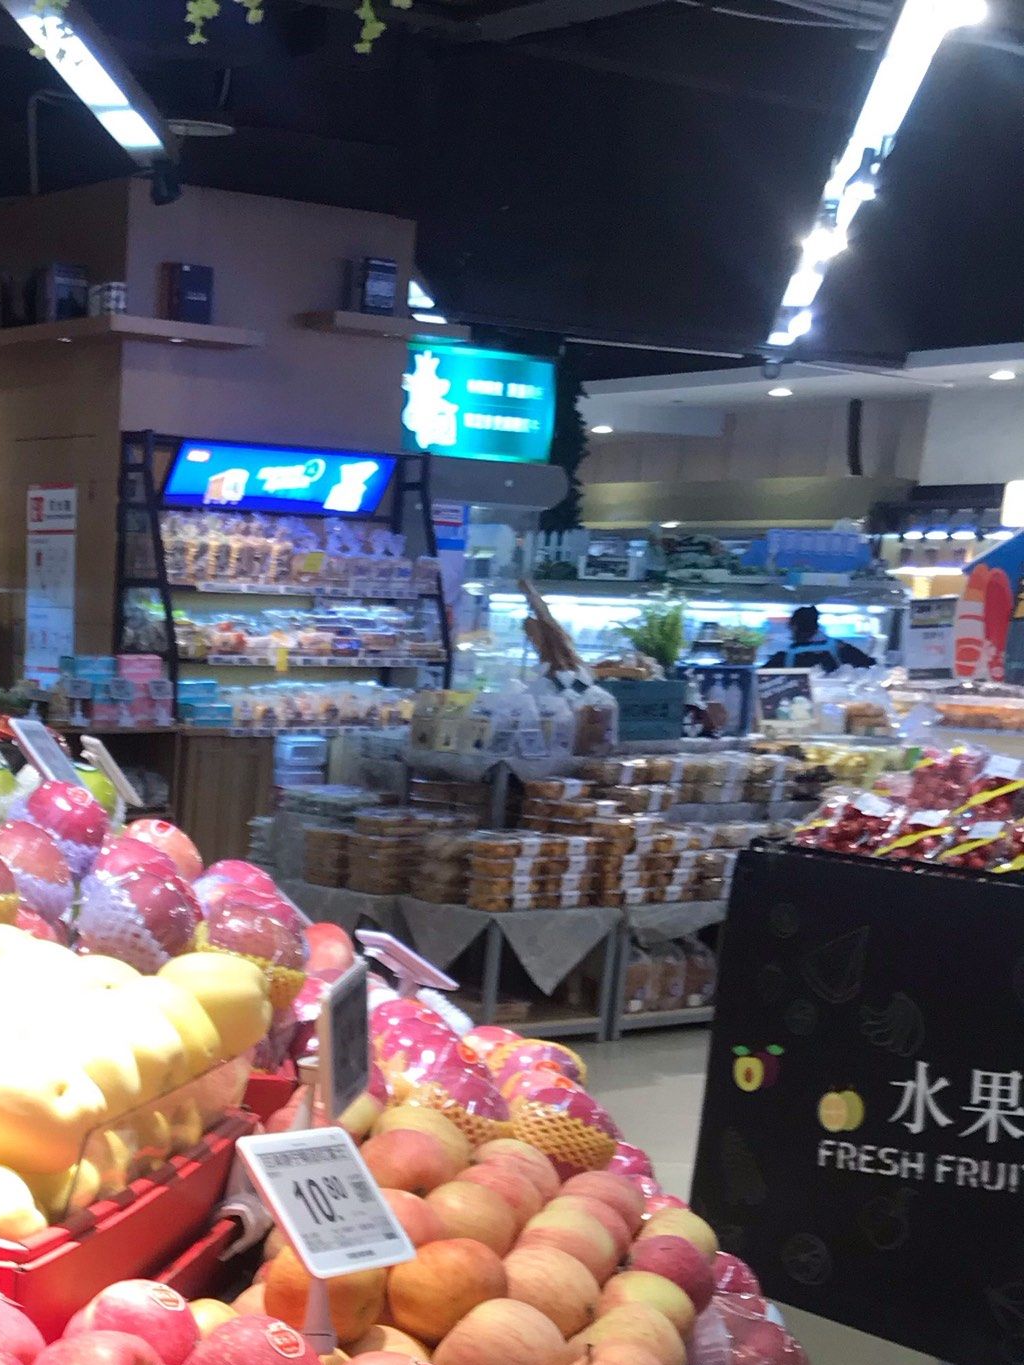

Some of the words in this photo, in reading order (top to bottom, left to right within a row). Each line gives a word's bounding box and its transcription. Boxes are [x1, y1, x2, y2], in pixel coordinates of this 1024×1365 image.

[888, 1060, 1024, 1144] 水果
[817, 1138, 925, 1181] FRESH
[933, 1154, 1024, 1194] FRUI
